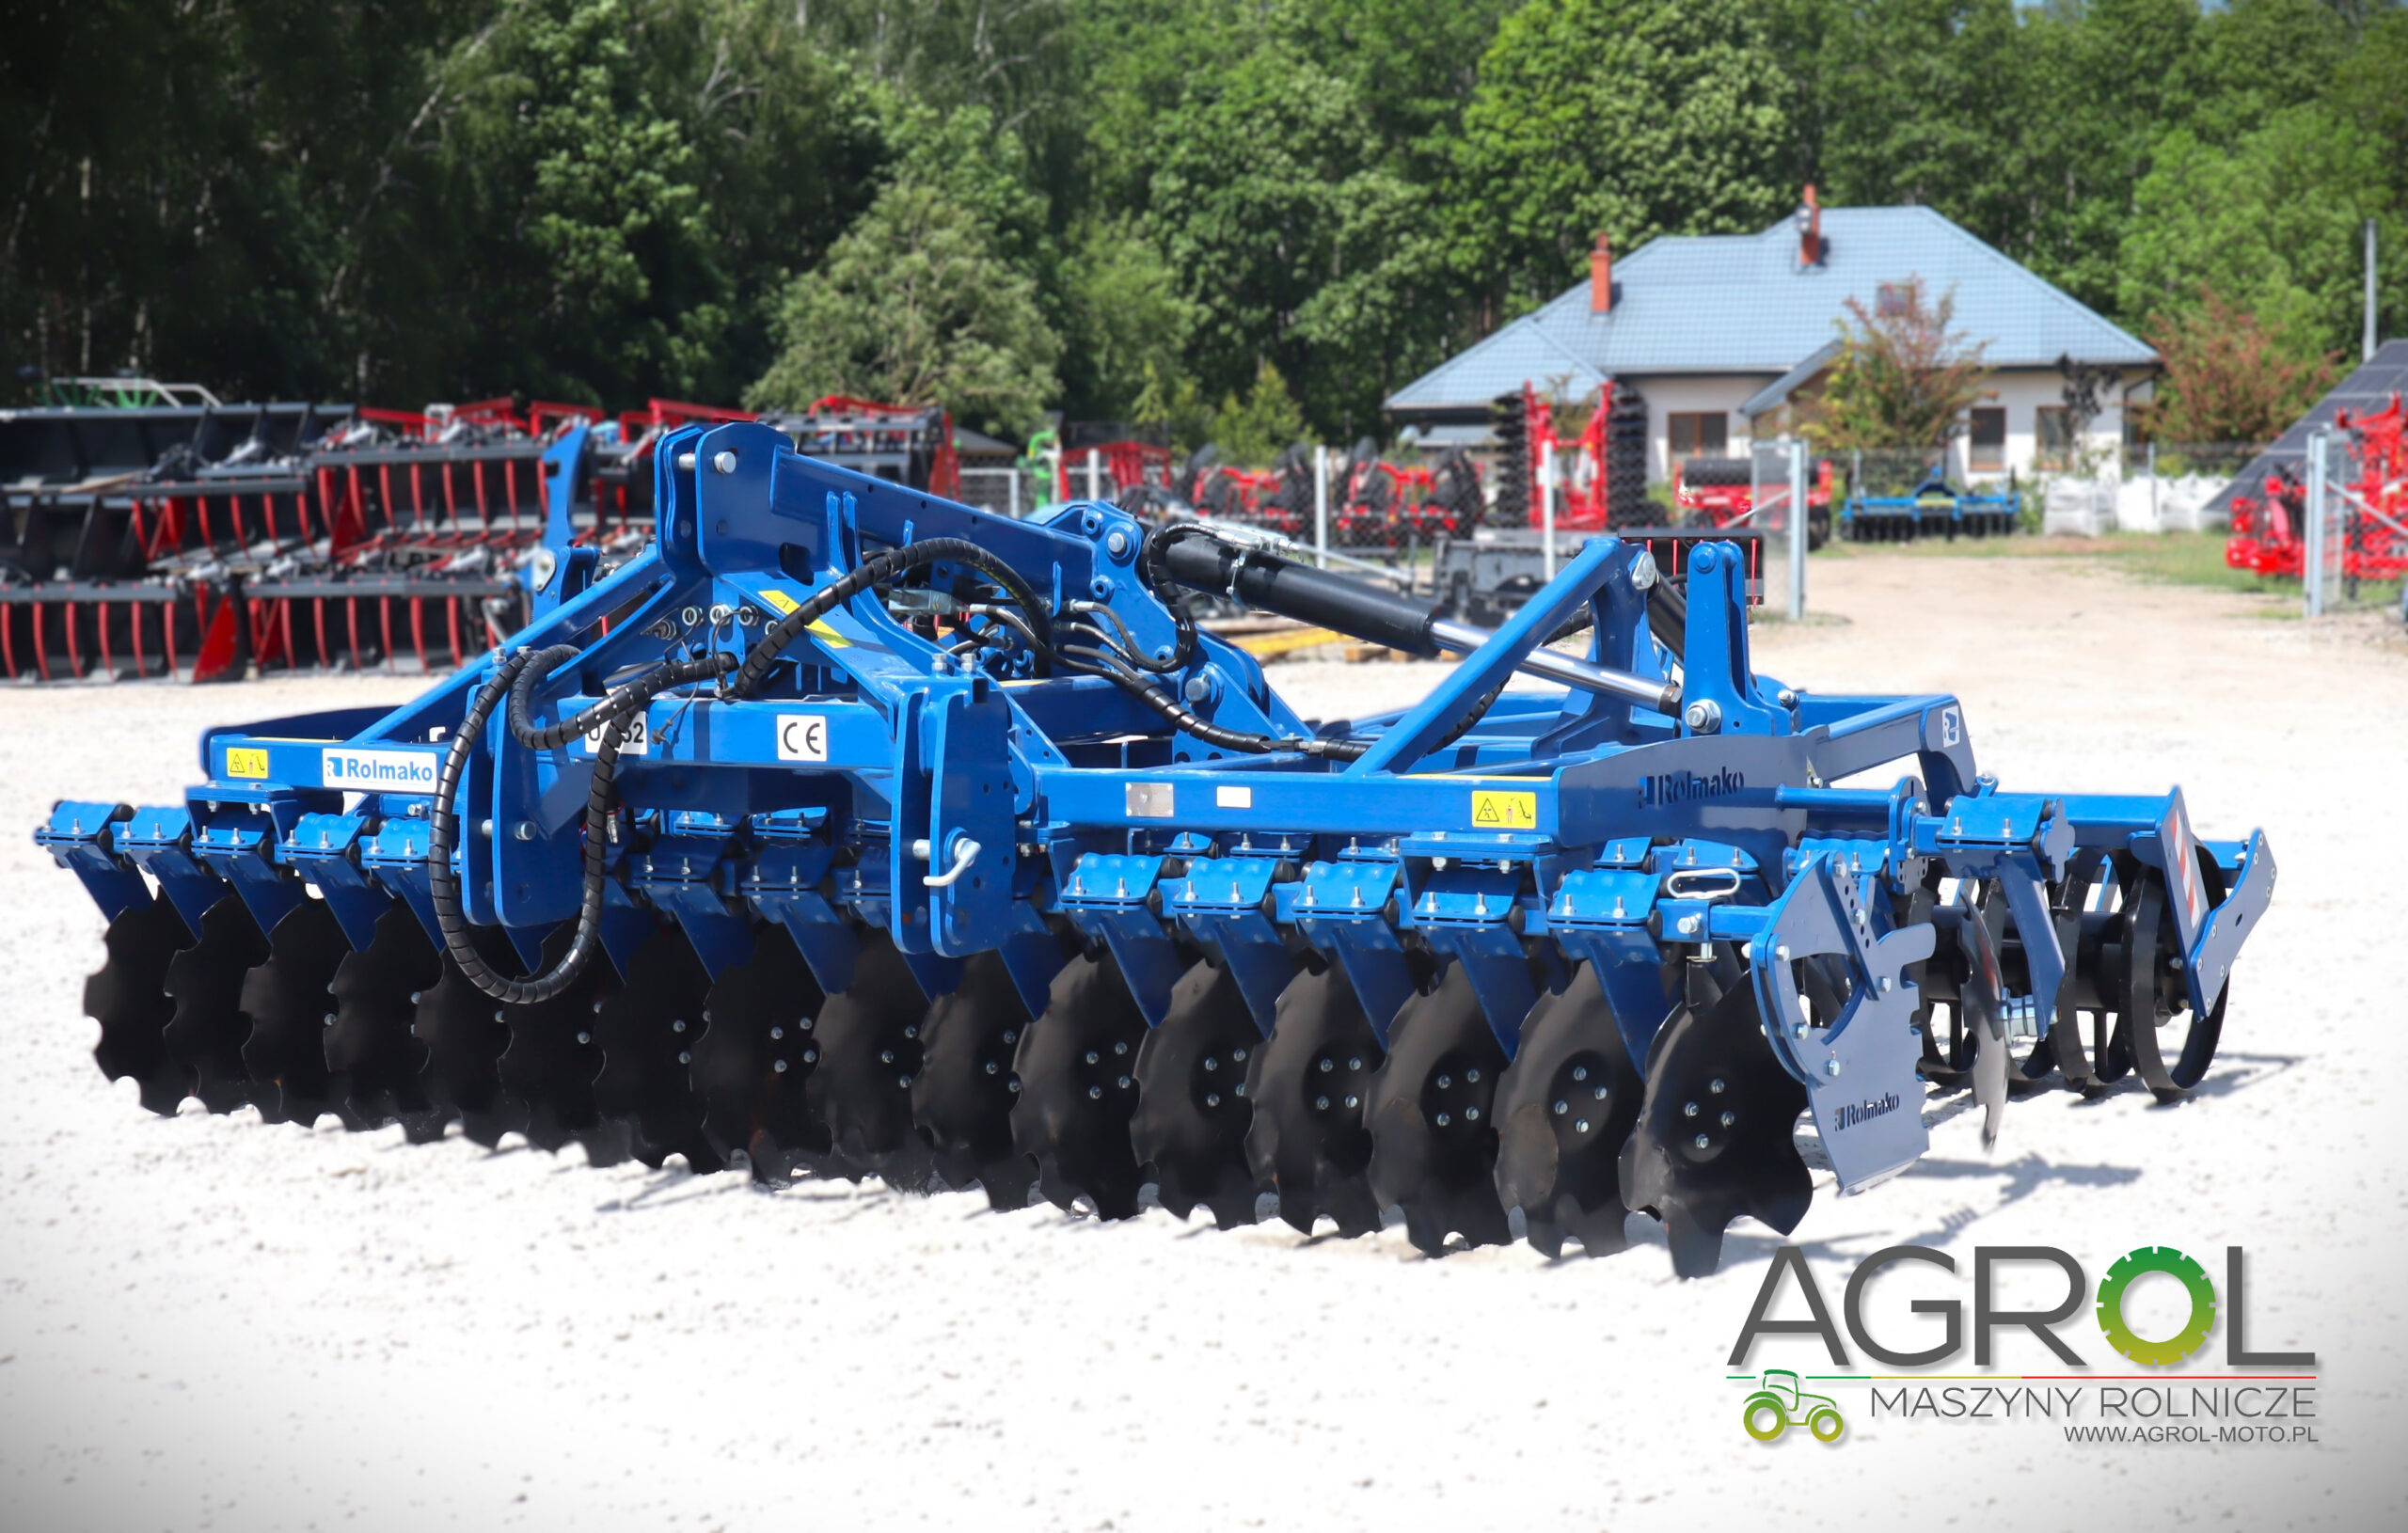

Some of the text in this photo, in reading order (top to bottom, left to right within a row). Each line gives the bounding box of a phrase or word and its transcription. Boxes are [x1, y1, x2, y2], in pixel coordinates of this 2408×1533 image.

[783, 721, 821, 755] CE
[346, 758, 434, 782] Rolmako
[1657, 766, 1745, 806] Rolmako
[1846, 1092, 1900, 1128] Rolmako
